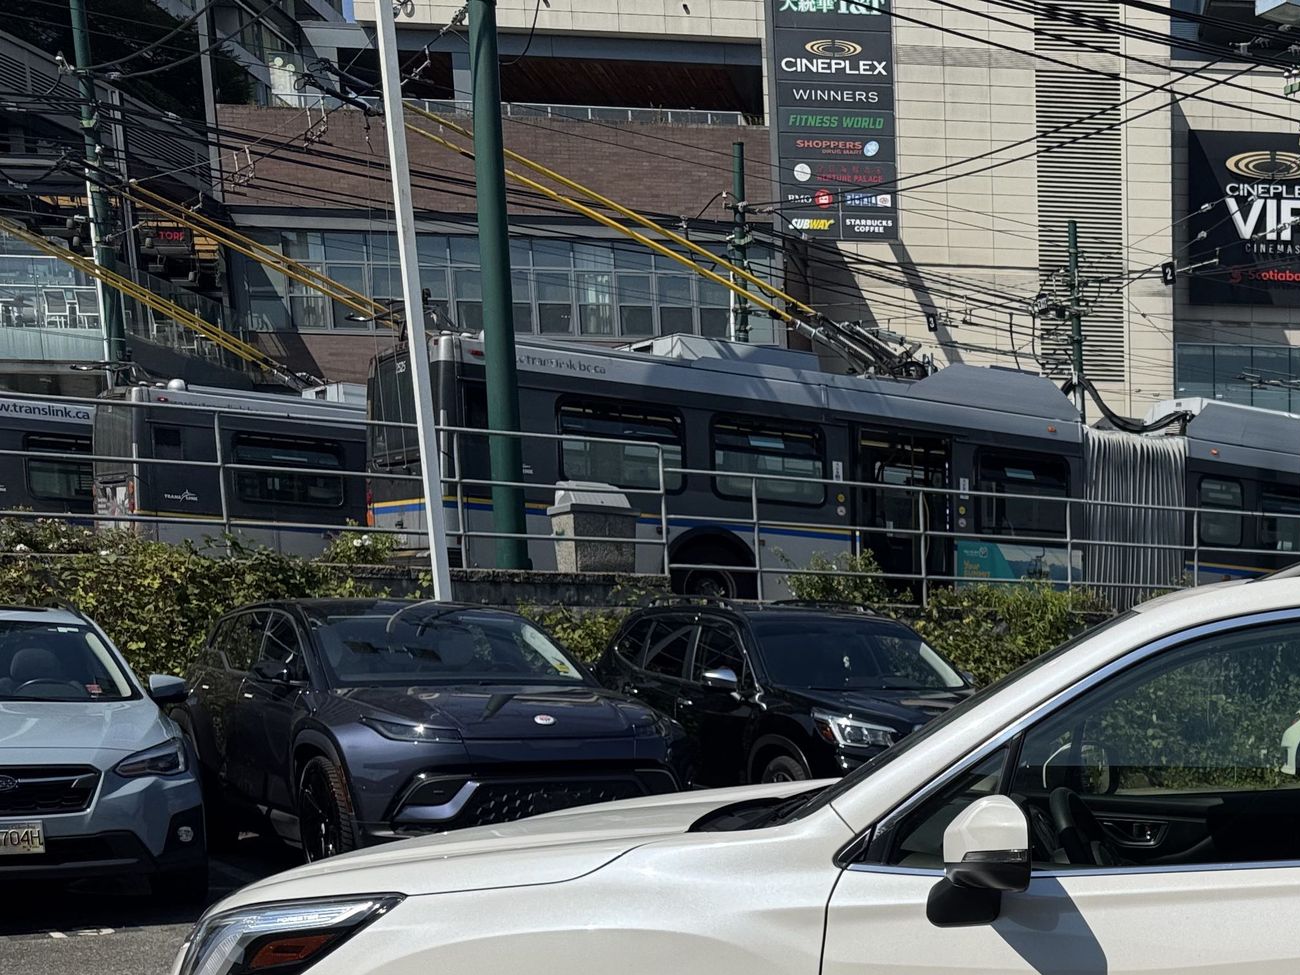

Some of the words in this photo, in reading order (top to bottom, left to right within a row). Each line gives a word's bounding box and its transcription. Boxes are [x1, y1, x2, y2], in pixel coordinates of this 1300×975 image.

[781, 57, 888, 75] CINEPLEX
[793, 89, 879, 103] WINNERS
[788, 114, 838, 128] FITNESS
[842, 116, 884, 129] WORLD
[796, 139, 862, 150] SHOPPERS
[788, 218, 835, 230] SUBWAY
[845, 218, 893, 227] STARBUCKS
[1245, 243, 1300, 255] CINEMAS
